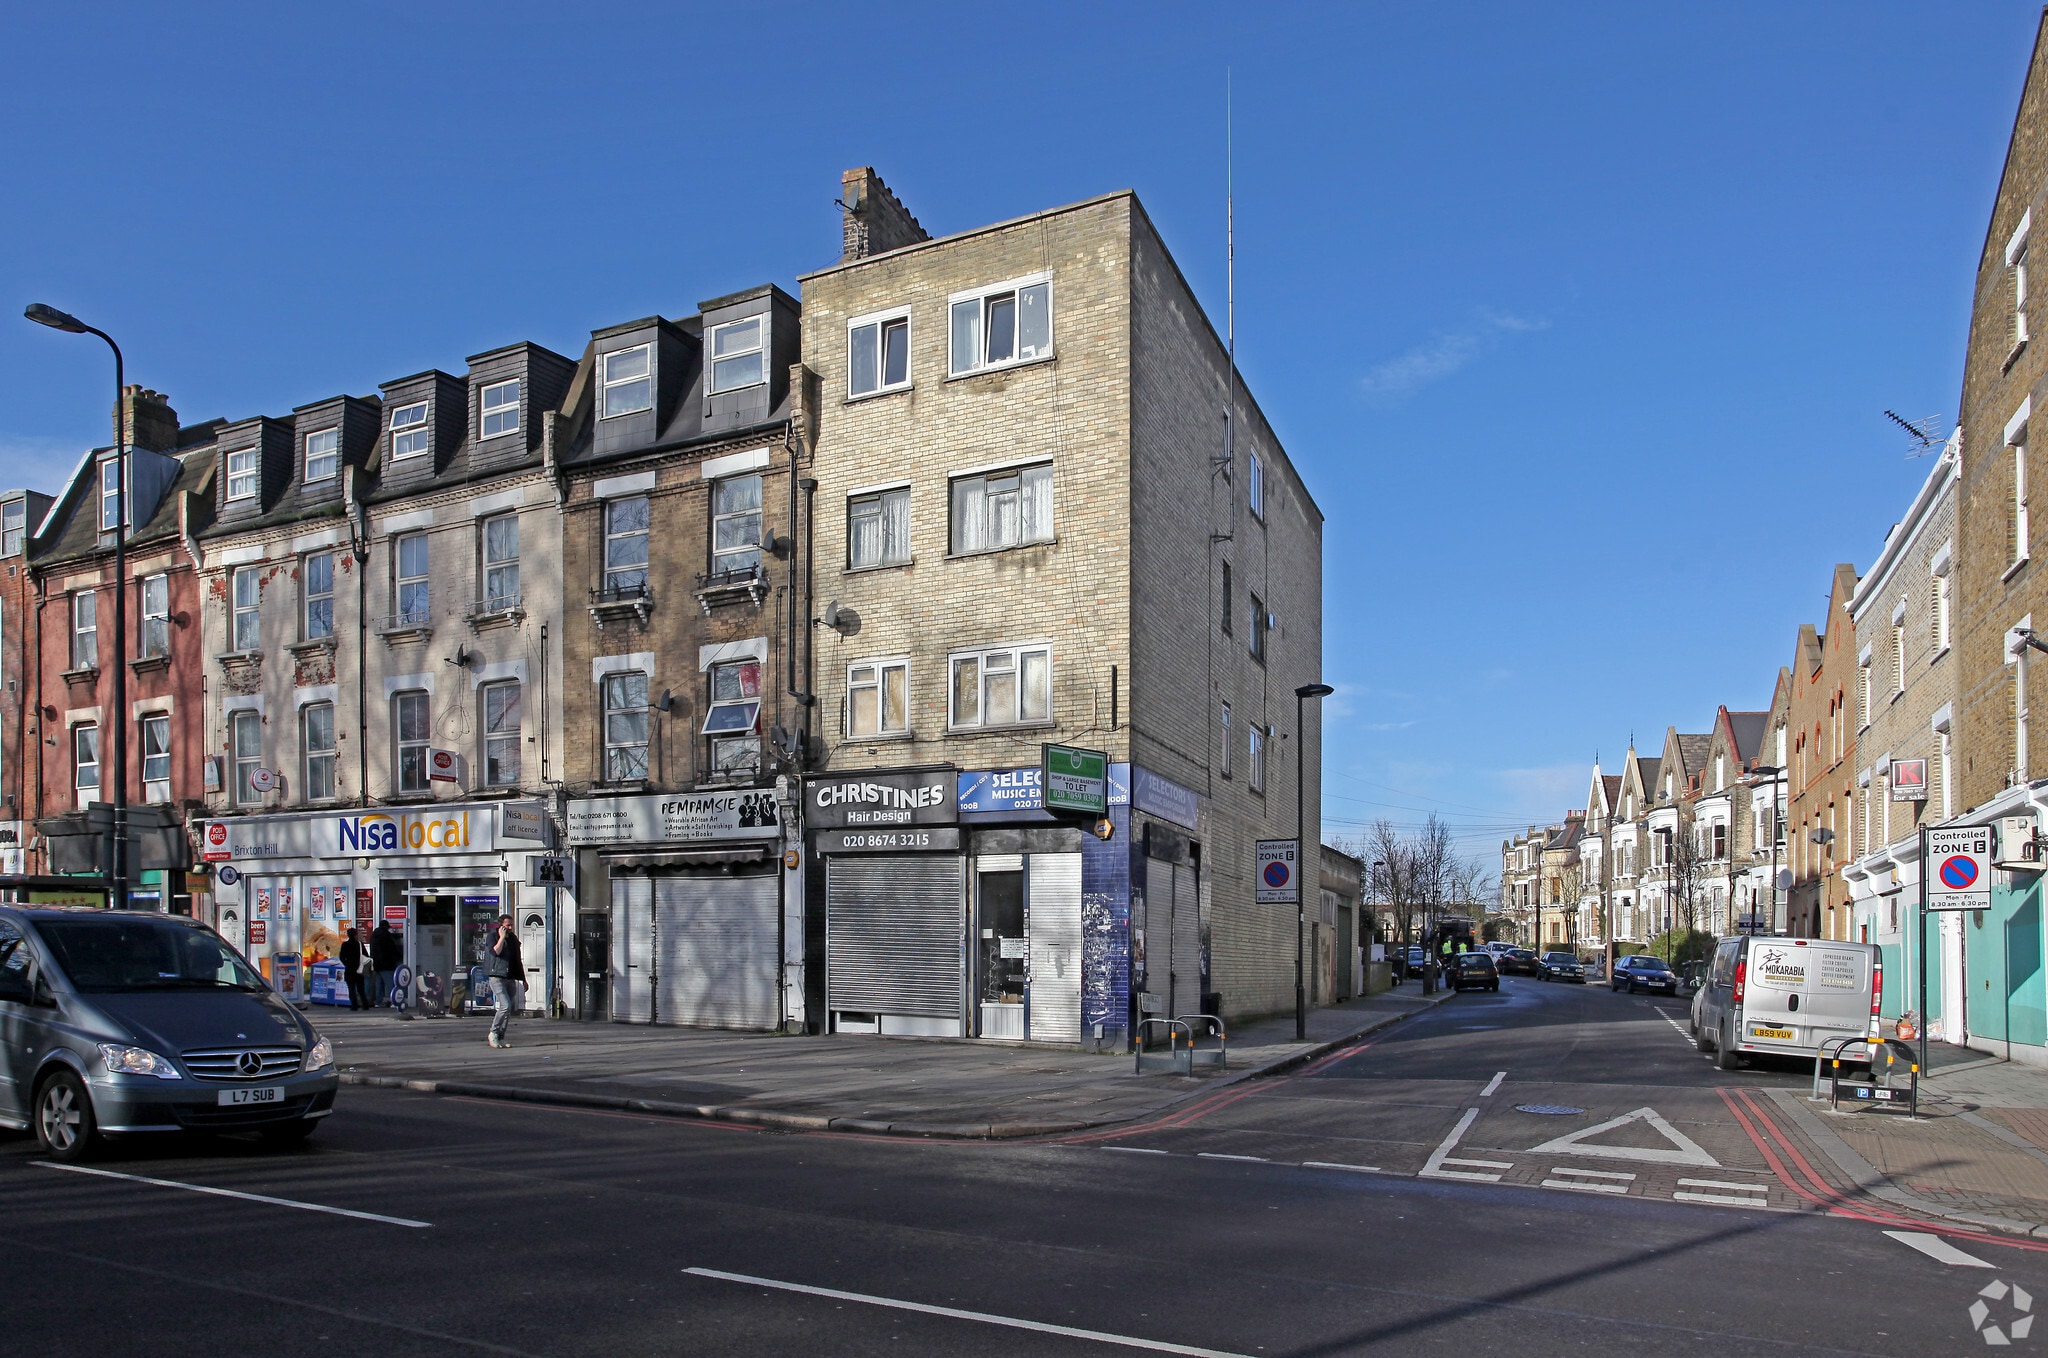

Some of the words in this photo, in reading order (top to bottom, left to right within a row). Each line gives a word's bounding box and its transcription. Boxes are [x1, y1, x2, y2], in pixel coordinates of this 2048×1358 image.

[1897, 762, 1921, 784] K
[1065, 782, 1073, 790] TO
[1148, 775, 1186, 804] SELECTORS
[816, 782, 944, 809] CHRISTINES
[992, 789, 1026, 799] MUSIC
[1107, 795, 1126, 803] 100B
[662, 798, 737, 815] PEMPAMSIE
[506, 810, 521, 819] Nisa
[523, 812, 540, 822] local
[848, 812, 870, 823] Hair
[873, 810, 911, 823] Design
[340, 814, 397, 851] Nisa
[401, 811, 470, 849] local
[517, 825, 538, 834] licence
[1933, 830, 1985, 840] Controlled
[843, 836, 865, 847] 020
[868, 835, 896, 846] 8674
[900, 834, 929, 846] 3215
[235, 845, 262, 856] Brixton
[264, 844, 278, 855] Hill
[1933, 843, 1969, 854] ZONE
[473, 912, 491, 921] open
[478, 923, 487, 932] 24
[1765, 964, 1804, 976] MOKARABIA
[1754, 1029, 1774, 1038] LB59
[233, 1091, 248, 1103] L7
[253, 1089, 274, 1101] SUB
